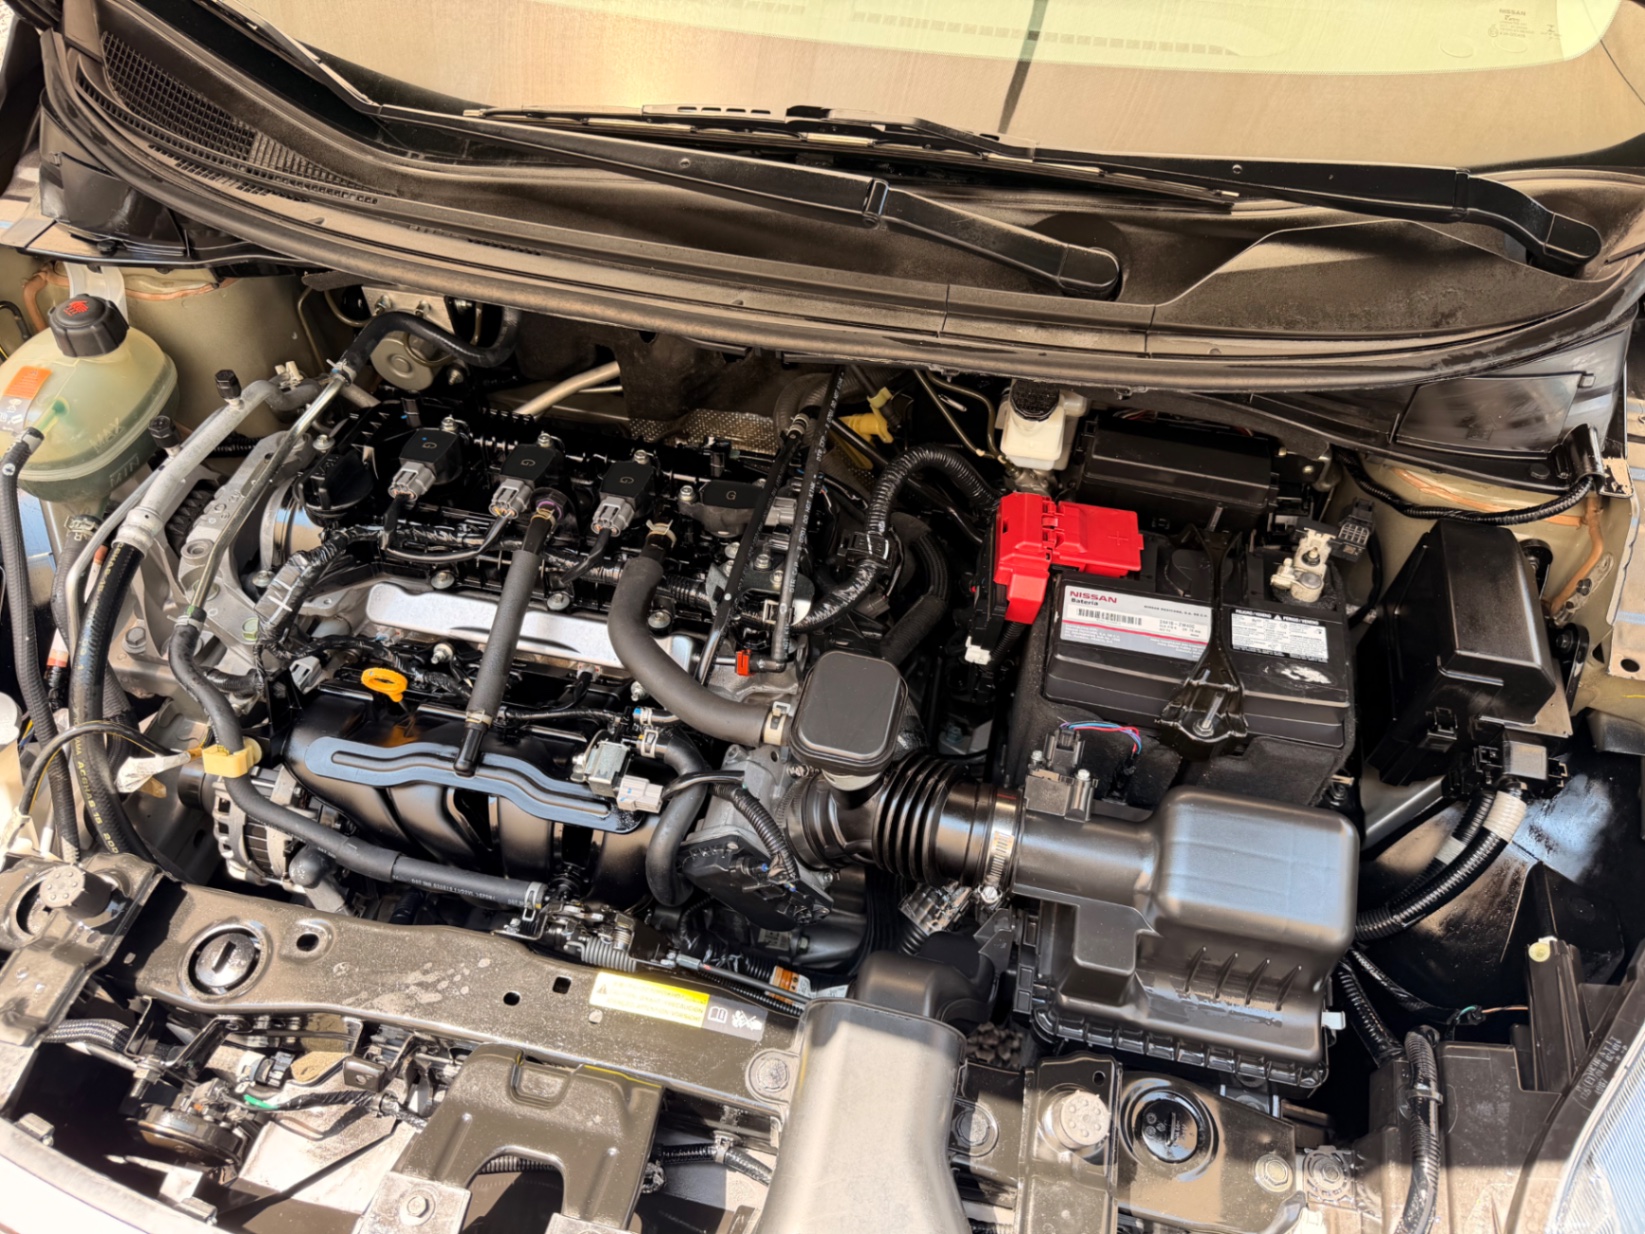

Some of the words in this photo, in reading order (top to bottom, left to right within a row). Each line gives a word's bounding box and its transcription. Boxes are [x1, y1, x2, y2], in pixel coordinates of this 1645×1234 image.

[90, 417, 122, 453] MAX
[110, 456, 140, 488] MIN
[725, 491, 738, 502] G
[1070, 591, 1117, 603] NISSAN
